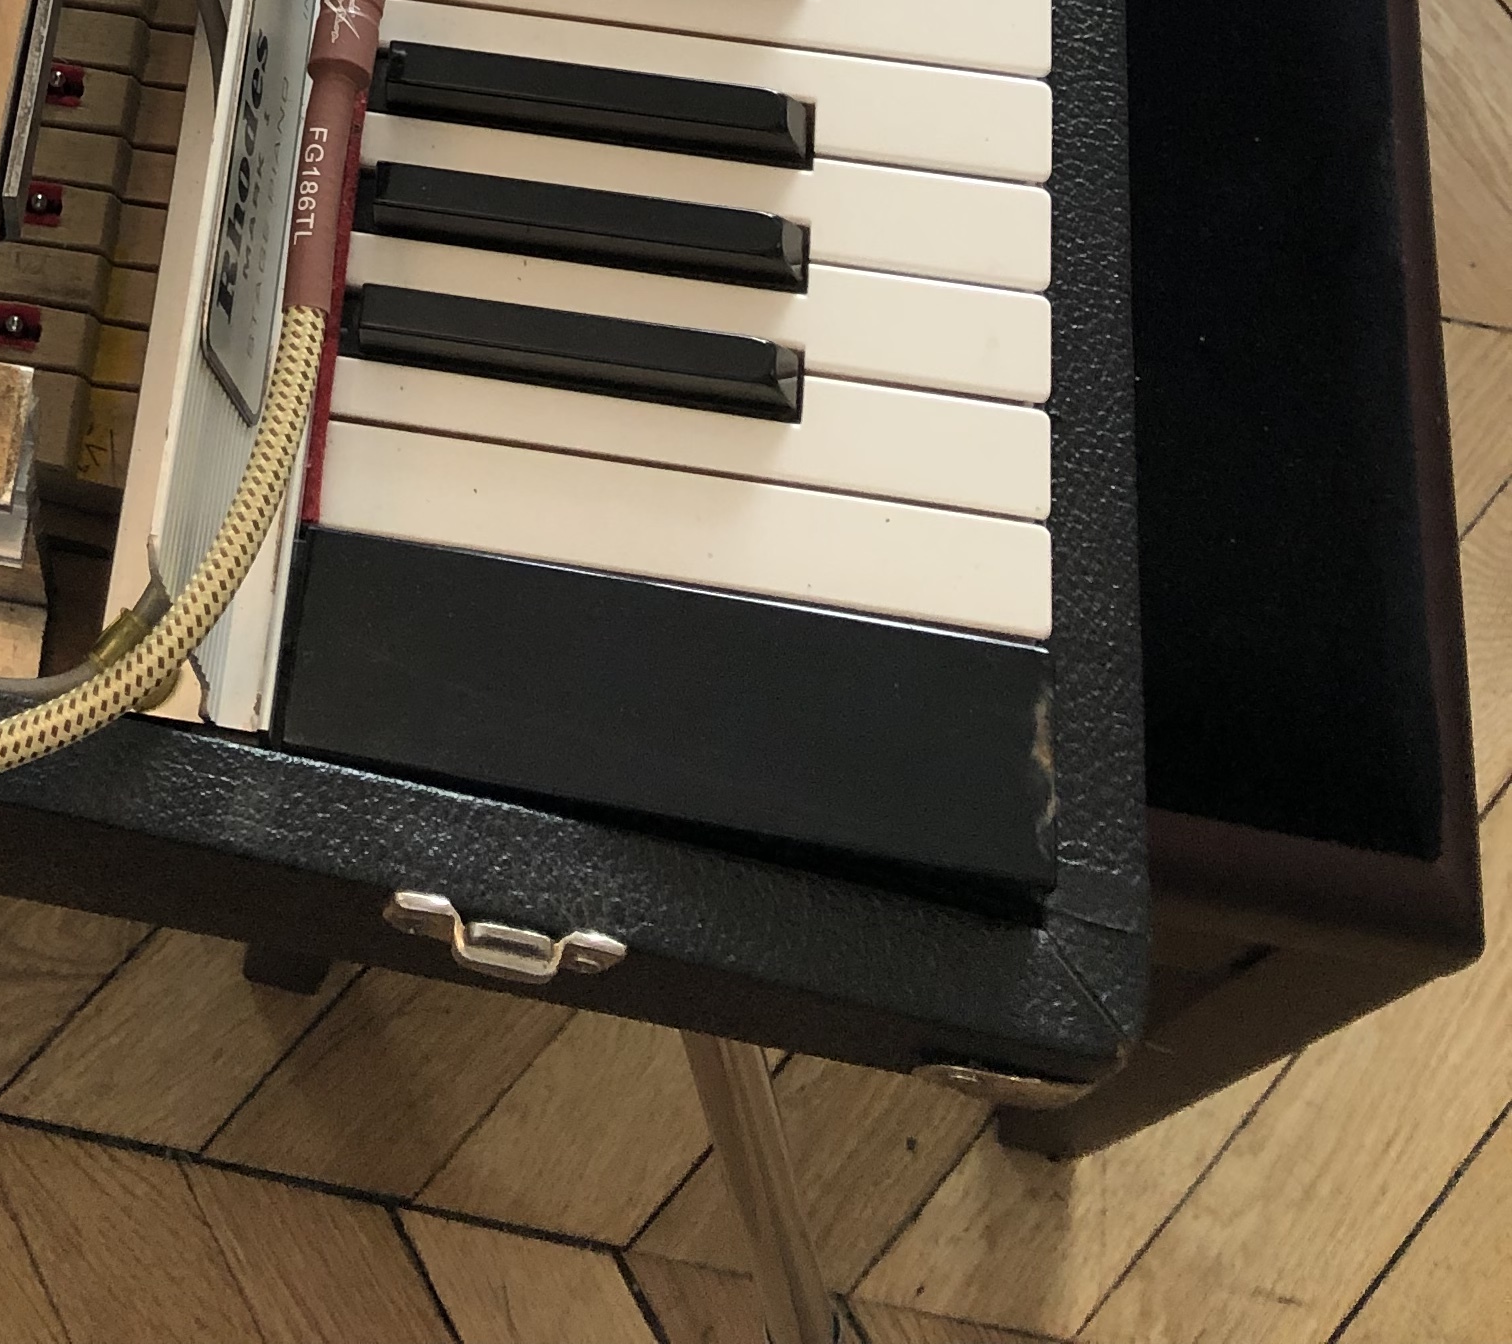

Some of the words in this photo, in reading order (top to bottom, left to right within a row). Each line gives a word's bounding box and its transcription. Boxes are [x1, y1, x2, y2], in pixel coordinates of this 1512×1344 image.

[217, 28, 269, 325] Rhodes
[242, 151, 265, 280] MARK
[246, 220, 269, 359] STAGE
[267, 76, 289, 205] PIANO
[293, 127, 329, 246] FG186TL
